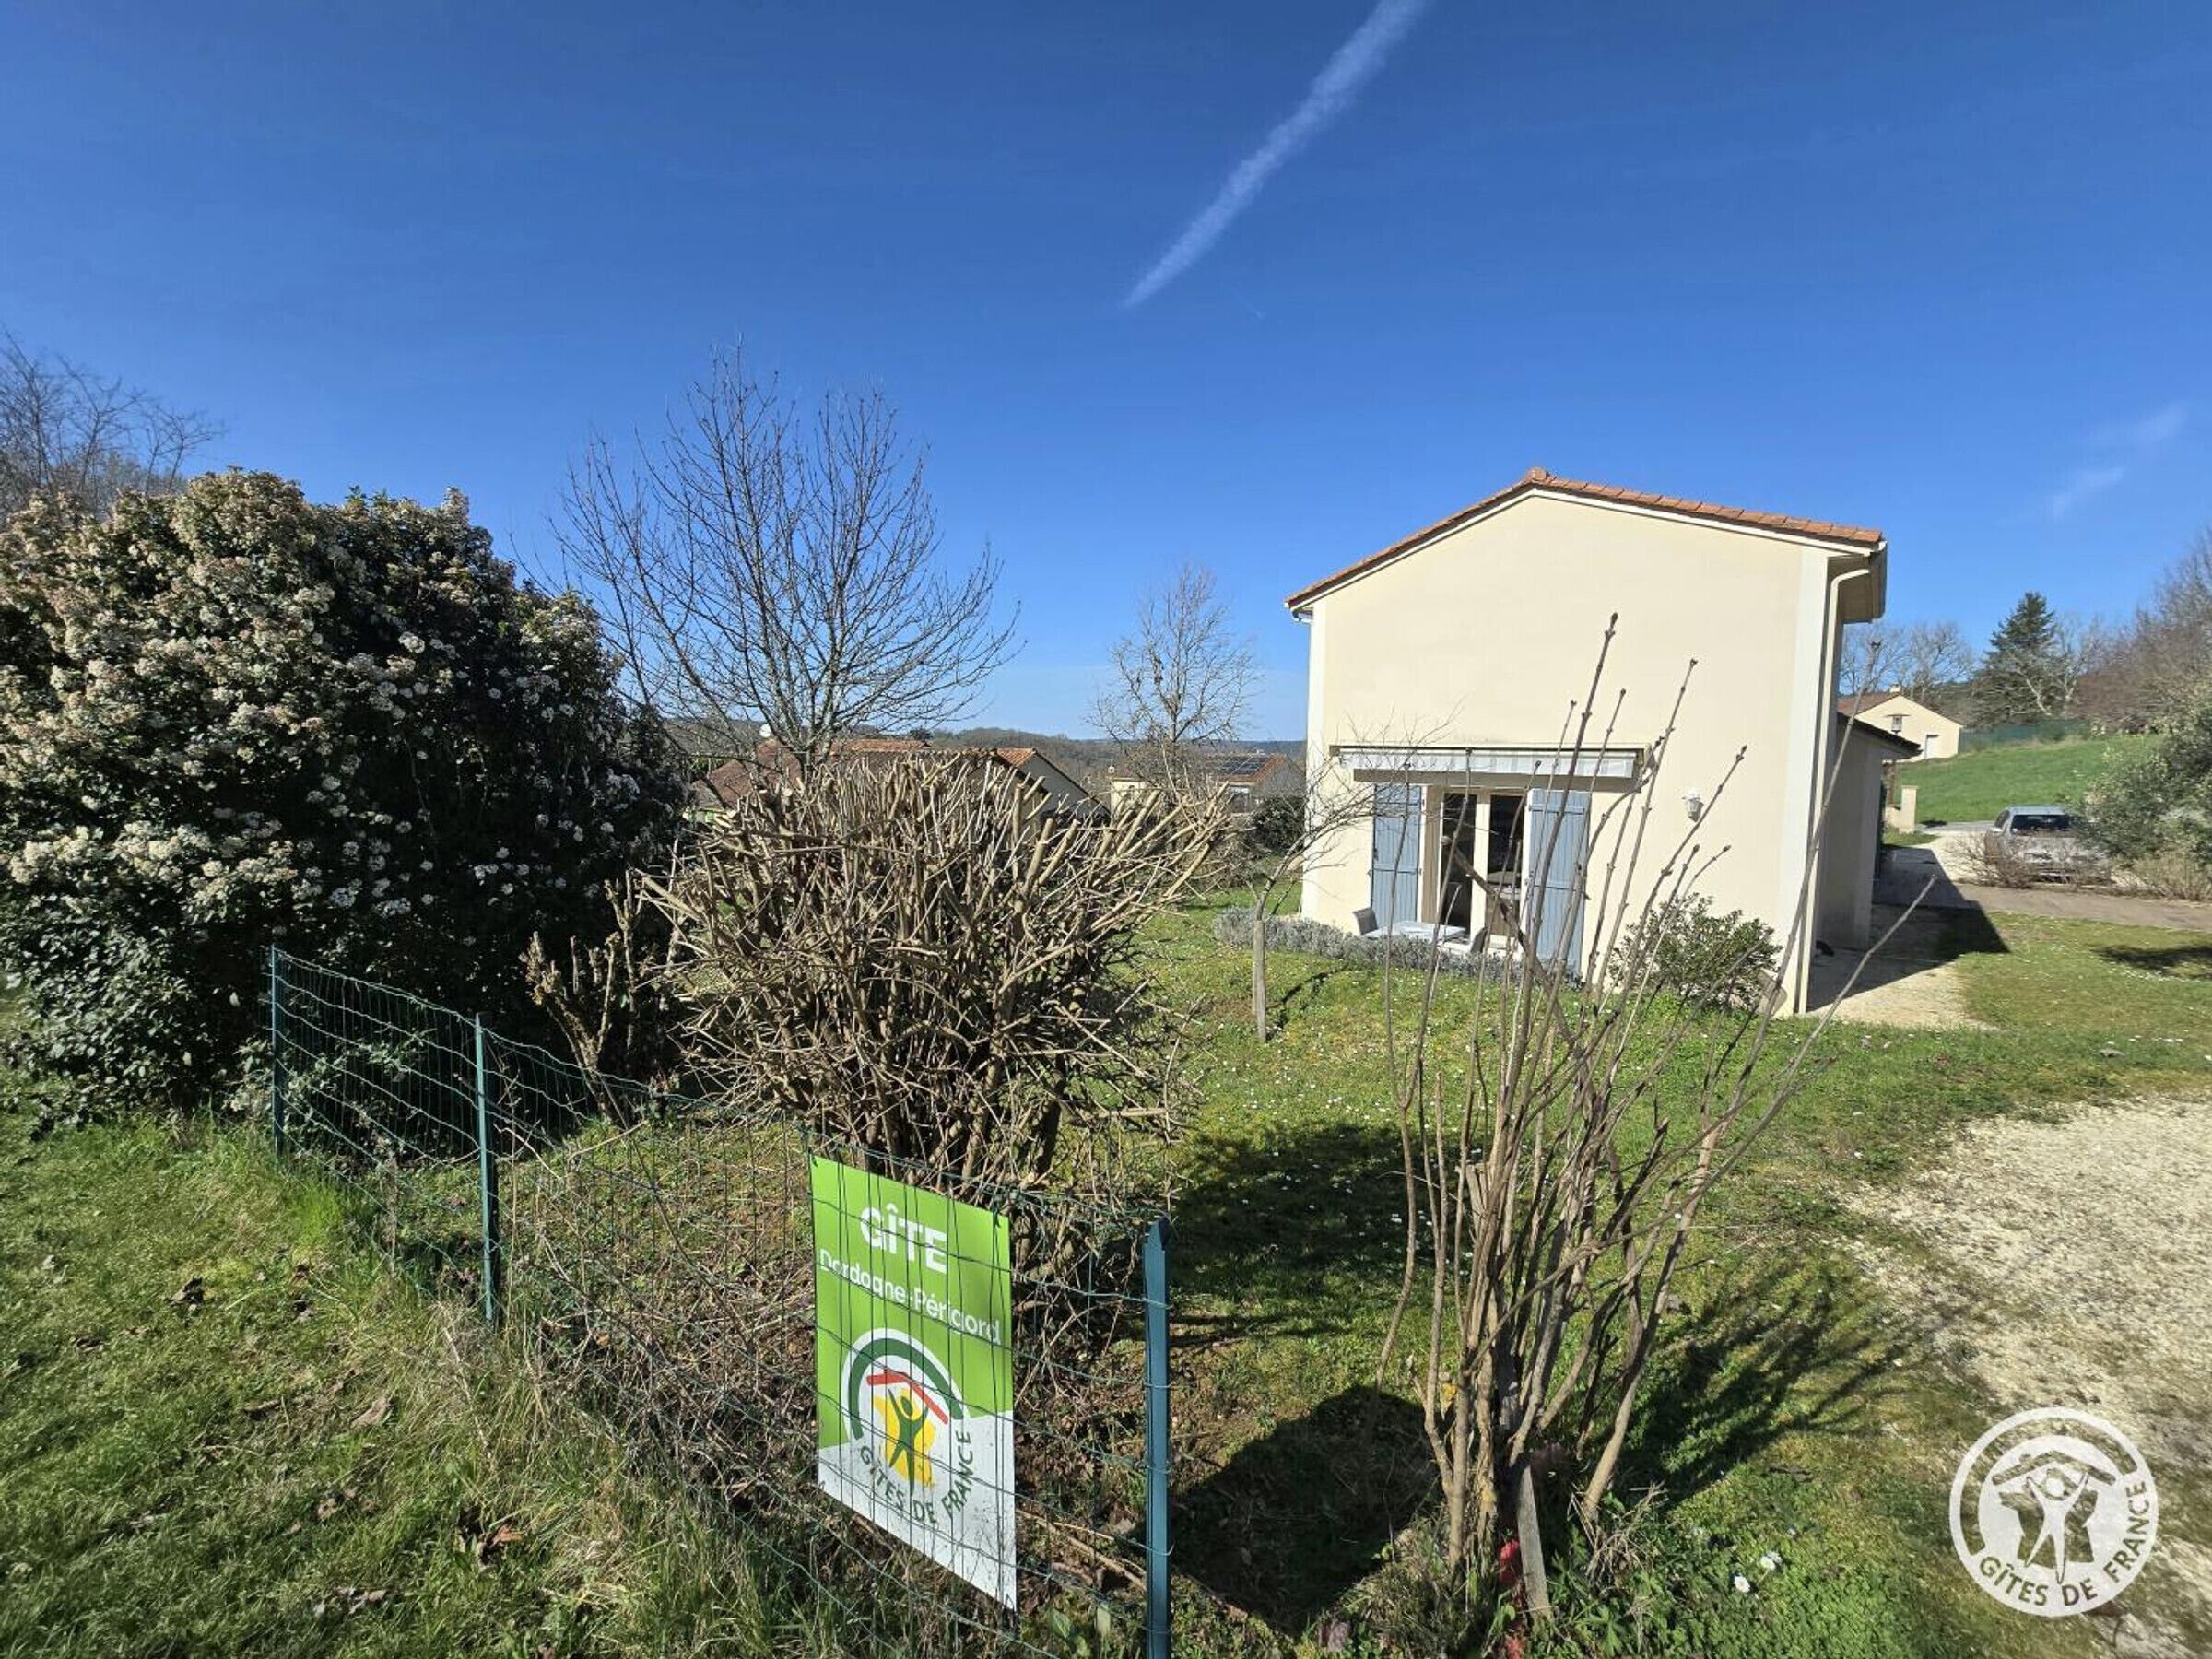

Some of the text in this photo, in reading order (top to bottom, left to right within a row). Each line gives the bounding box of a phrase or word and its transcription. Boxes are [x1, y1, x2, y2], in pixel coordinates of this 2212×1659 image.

[861, 1203, 948, 1274] GÎTE
[913, 1499, 938, 1523] DE
[941, 1430, 974, 1519] FRANCE
